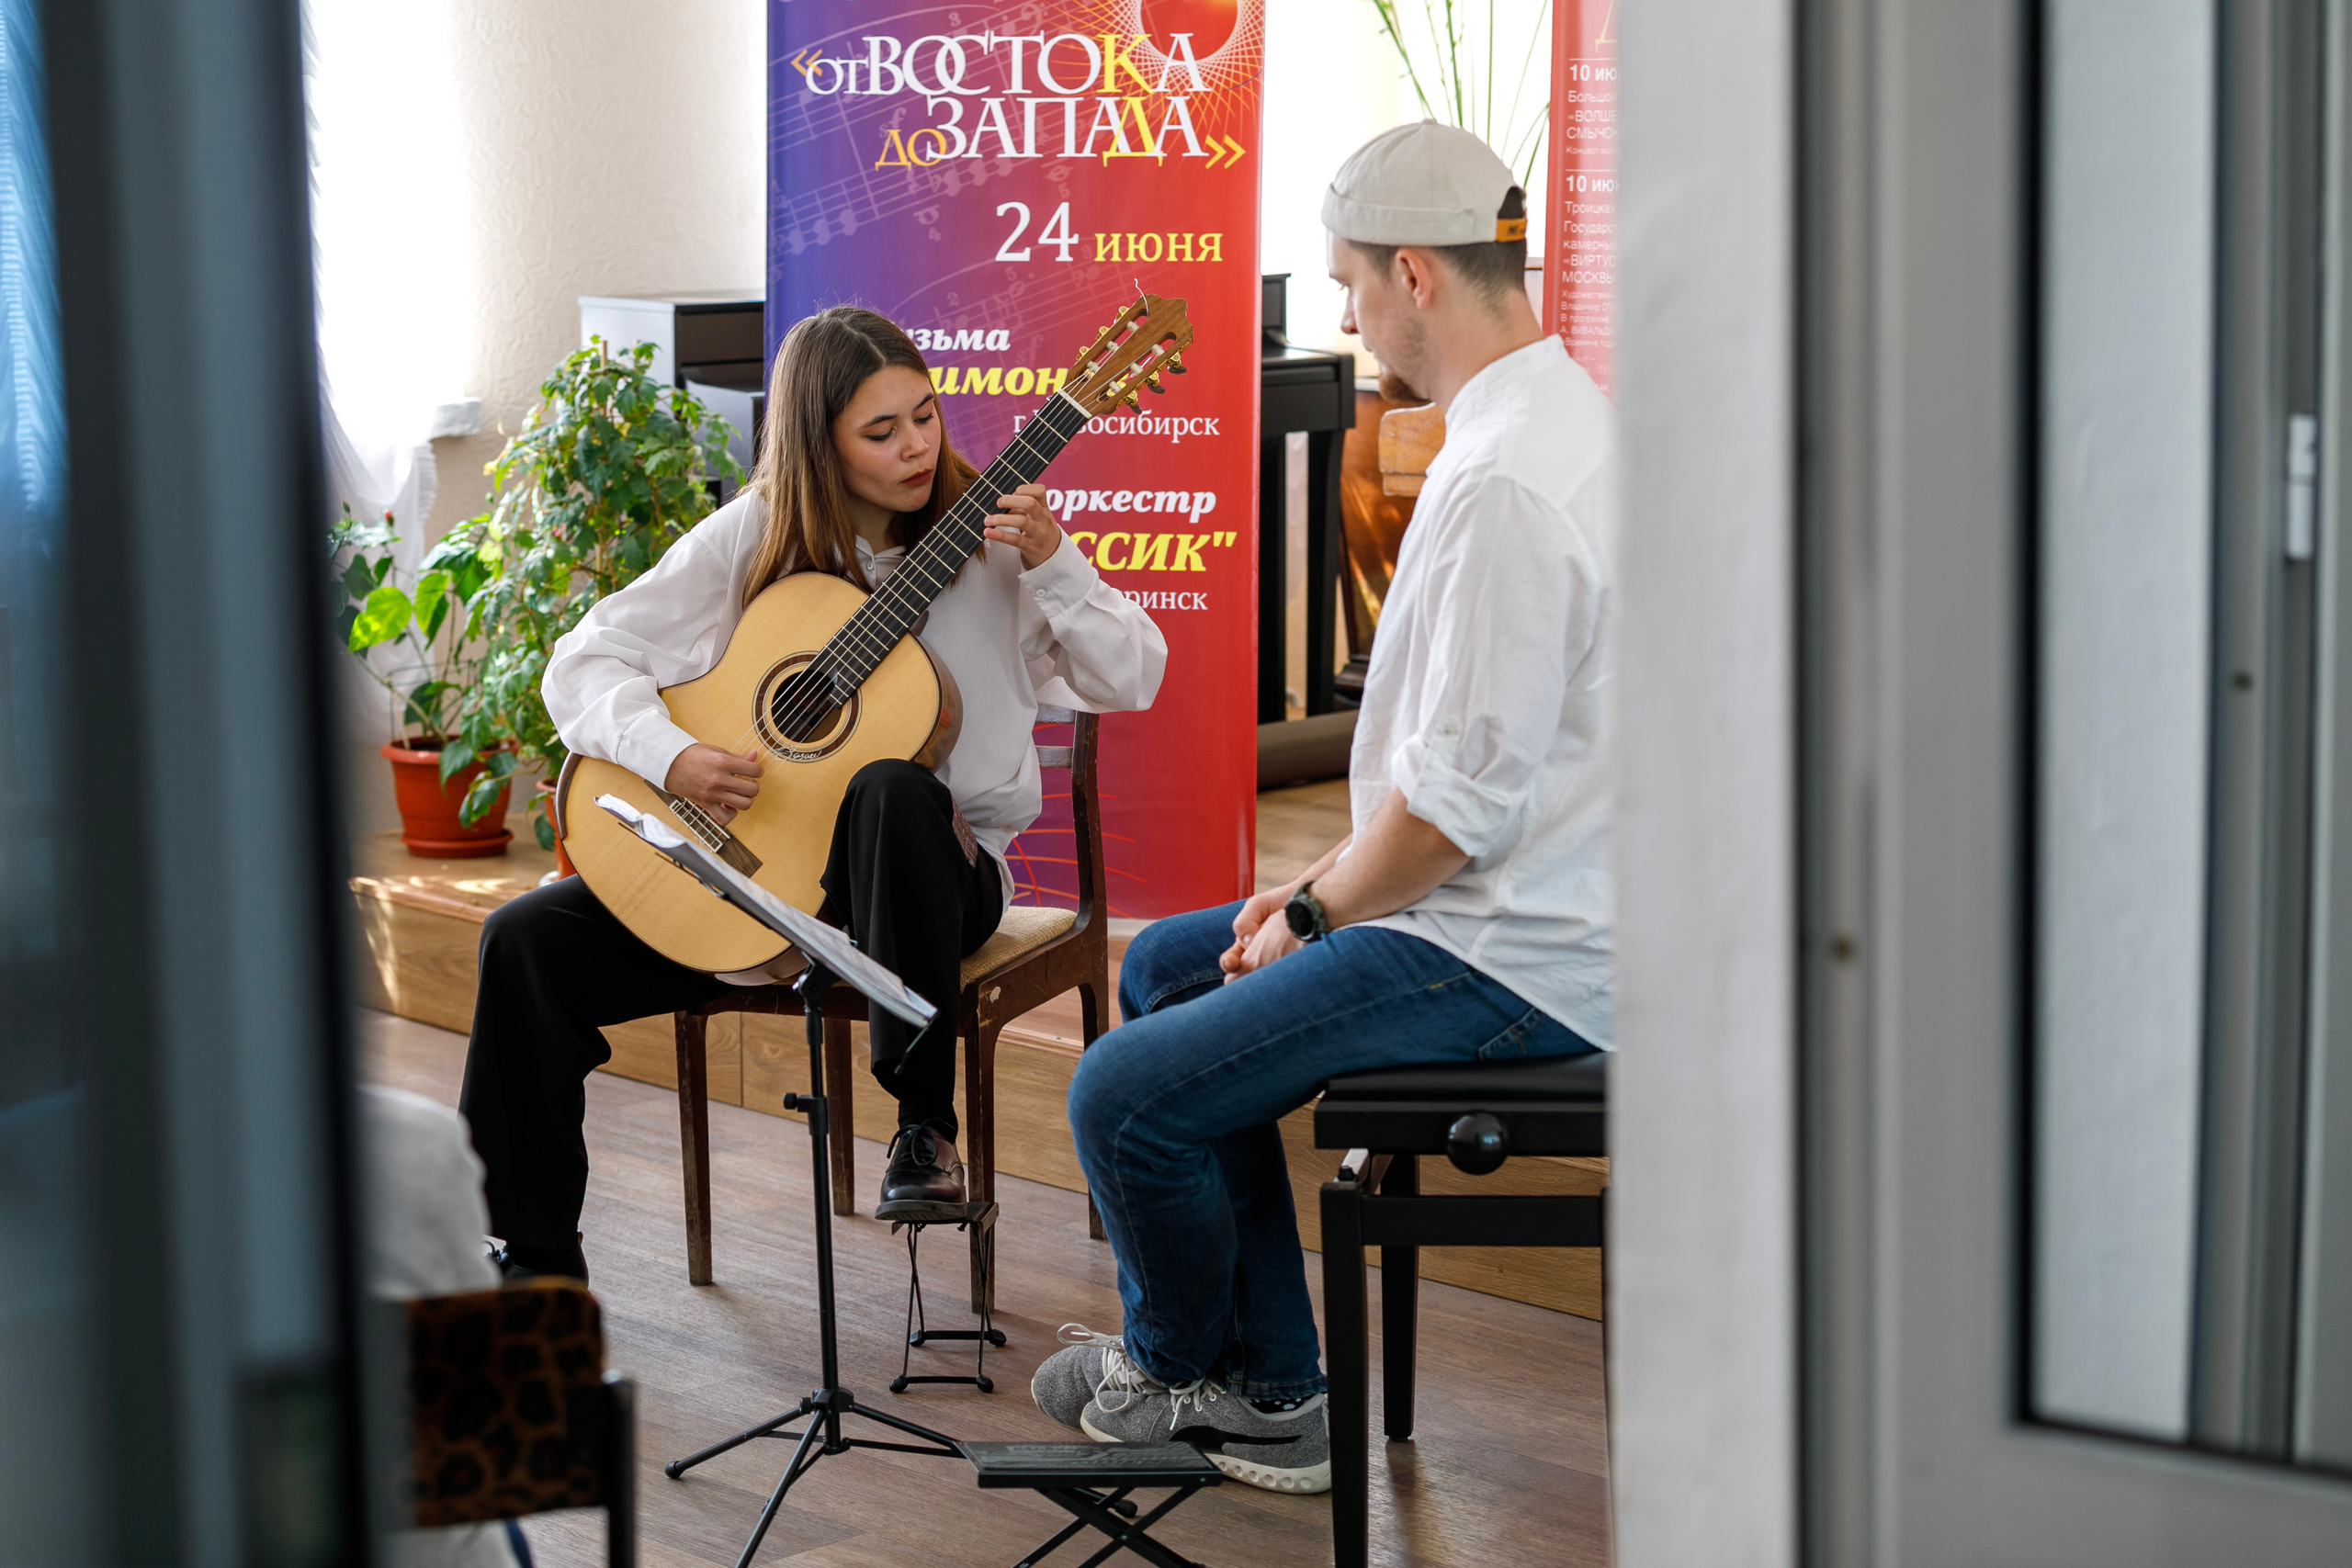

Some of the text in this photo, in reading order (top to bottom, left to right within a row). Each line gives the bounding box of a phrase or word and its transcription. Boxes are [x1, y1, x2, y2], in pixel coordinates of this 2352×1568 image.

[1569, 64, 1618, 82] 10 ию
[1567, 90, 1617, 103] Большой
[1567, 109, 1617, 122] «ВОЛШЕ
[1566, 175, 1588, 192] 10
[1564, 200, 1616, 216] Троицкая
[995, 201, 1224, 262] 24 июня
[1564, 220, 1618, 236] Государст
[1563, 254, 1617, 267] «ВИРТУО
[904, 328, 1012, 351] зьма
[927, 366, 1069, 396] имон
[1046, 489, 1216, 523] оркестр
[1069, 531, 1238, 571] ССИК"
[1121, 591, 1208, 610] ринск
